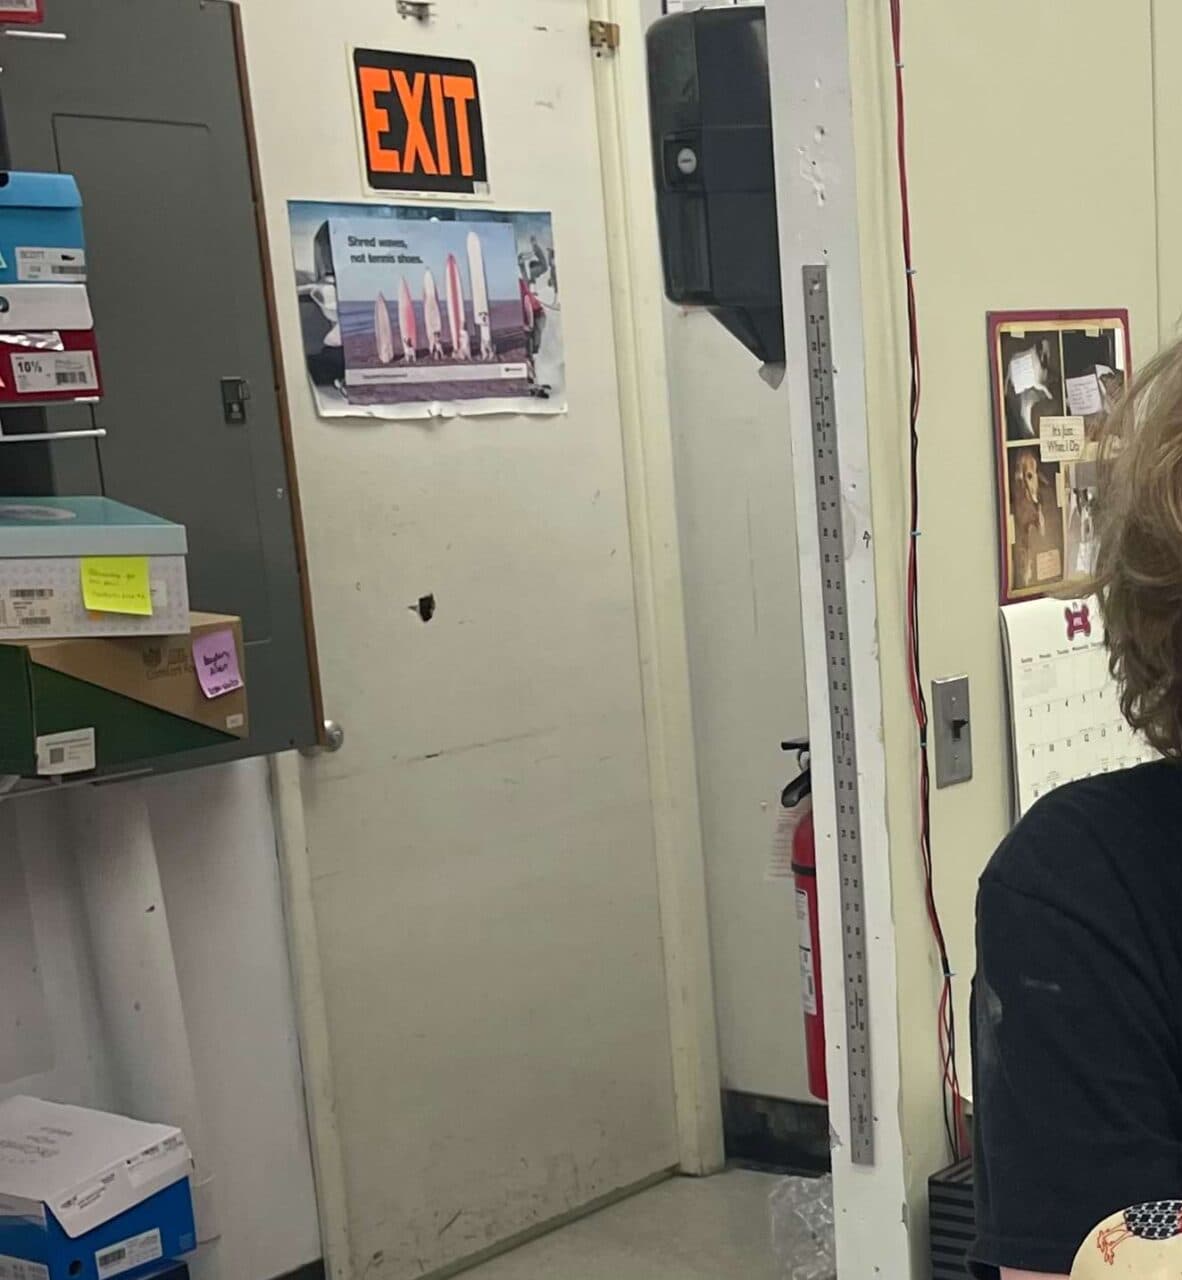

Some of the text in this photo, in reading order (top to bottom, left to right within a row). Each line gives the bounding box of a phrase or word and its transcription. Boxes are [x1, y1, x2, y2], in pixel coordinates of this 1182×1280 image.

[358, 65, 475, 177] EXIT
[348, 235, 376, 247] Shred
[350, 253, 366, 263] not
[367, 253, 396, 263] tennis
